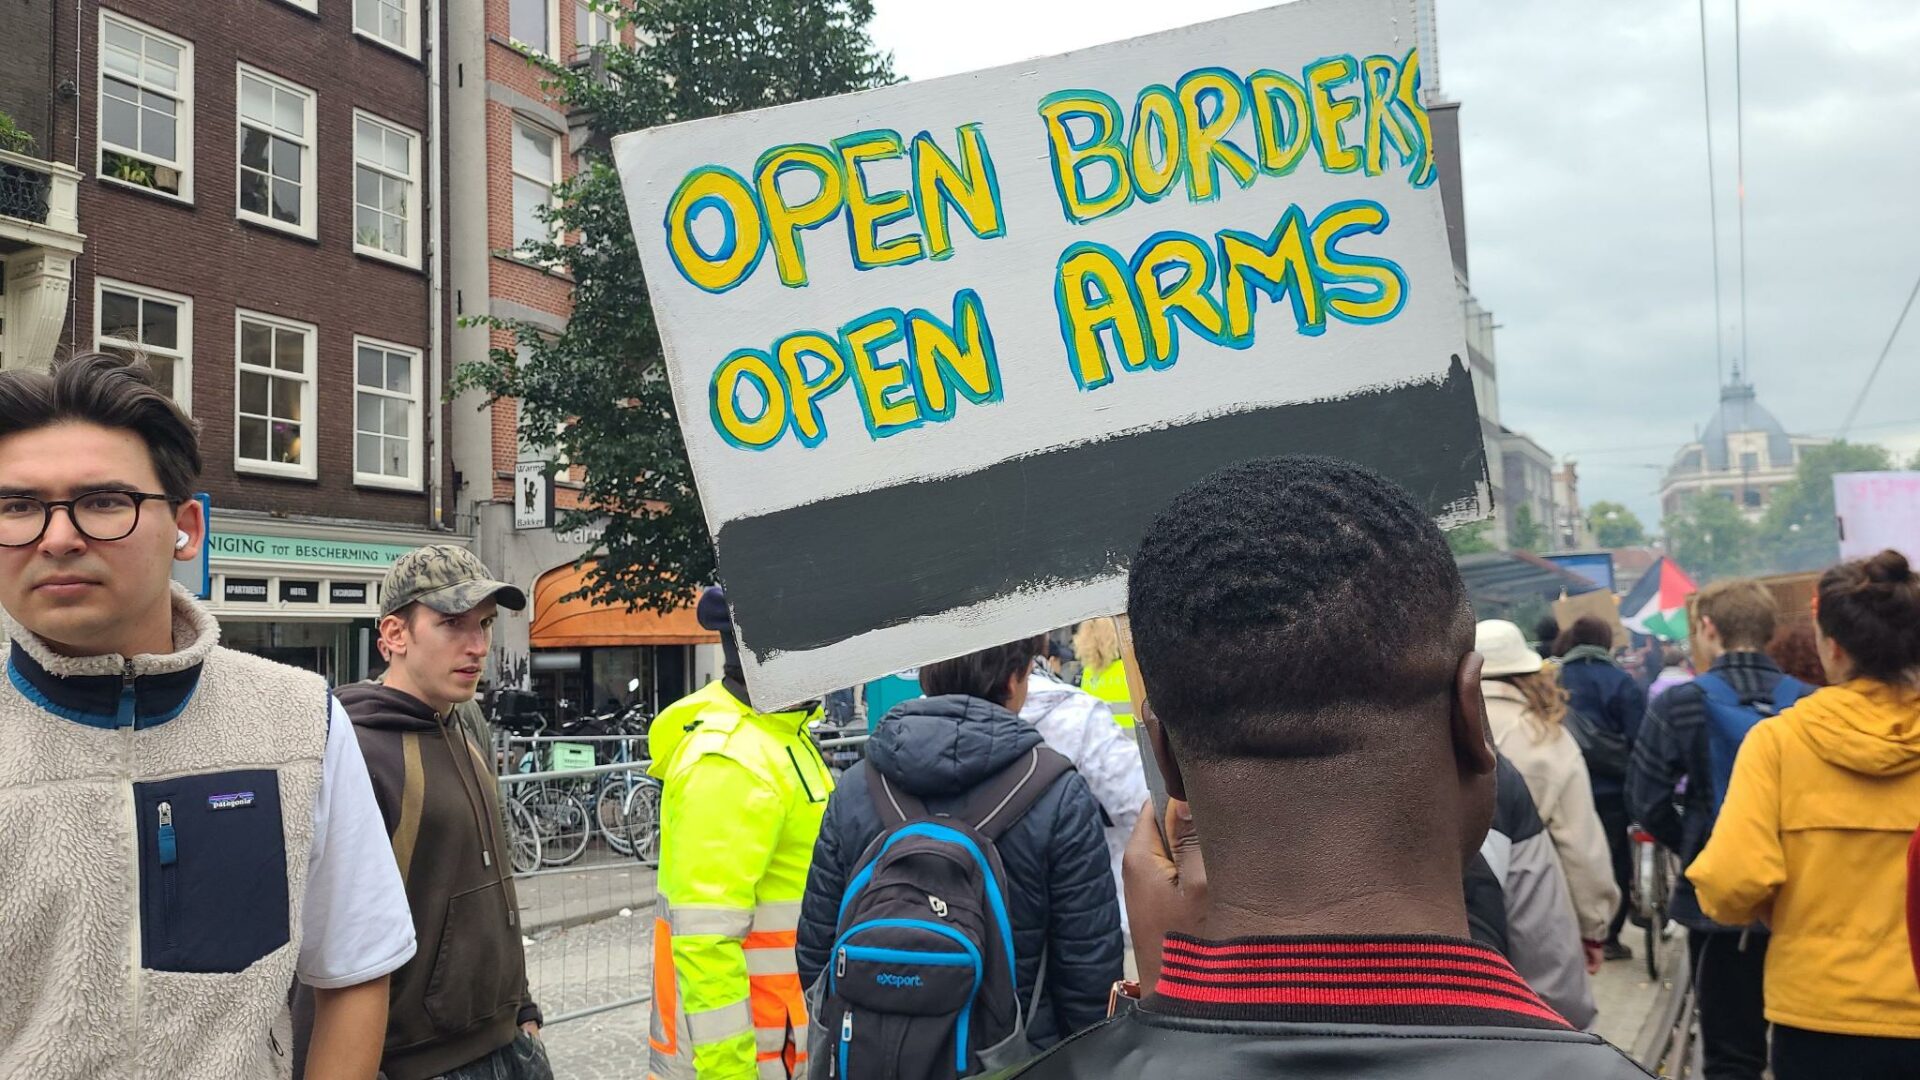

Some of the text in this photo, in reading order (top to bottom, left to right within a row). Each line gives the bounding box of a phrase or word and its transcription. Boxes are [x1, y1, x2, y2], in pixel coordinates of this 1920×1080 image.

[665, 124, 1006, 293] OPEN
[709, 199, 1411, 450] OPEN ARMS
[517, 519, 544, 527] Bakker
[295, 545, 379, 561] BESCHERMING
[226, 585, 267, 595] APARTMENTS
[213, 799, 251, 808] patagonia
